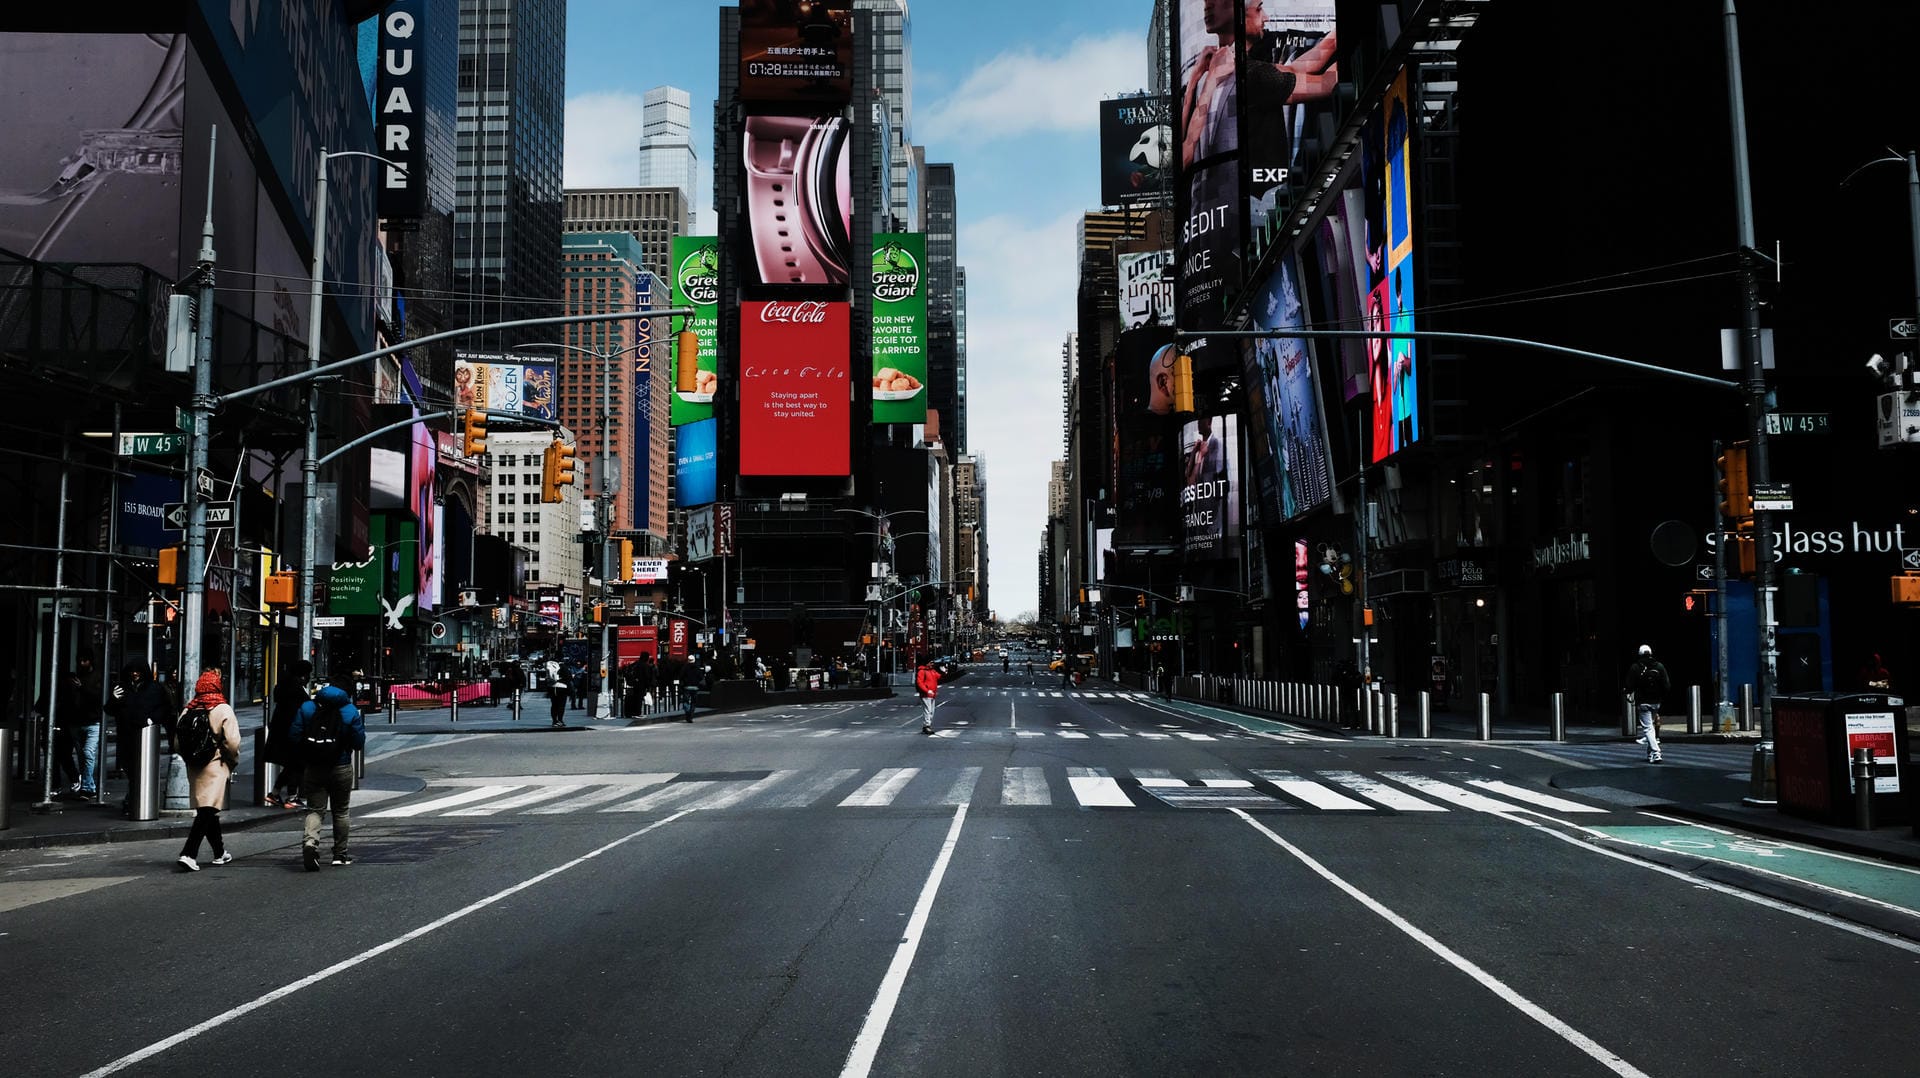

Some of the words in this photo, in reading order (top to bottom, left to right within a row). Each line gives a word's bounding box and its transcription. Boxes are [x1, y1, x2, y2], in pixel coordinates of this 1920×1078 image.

[334, 9, 352, 128] YOU
[749, 63, 782, 75] 07:28
[383, 11, 415, 189] QUARE
[1252, 168, 1289, 183] EXP
[291, 90, 346, 294] WORERS!
[1128, 252, 1171, 281] LITTLE
[873, 272, 916, 285] Green
[690, 287, 718, 299] Gia
[875, 284, 917, 297] Giant
[872, 336, 898, 344] EGGIE
[899, 336, 918, 344] TOT
[881, 346, 920, 354] ARRIVED
[474, 366, 485, 385] KING
[474, 385, 484, 405] LION
[504, 367, 519, 411] ROZEN
[770, 391, 798, 401] Staying
[799, 392, 818, 401] apart
[773, 410, 789, 419] stay
[790, 410, 815, 418] united.
[802, 403, 817, 411] way
[1782, 417, 1794, 432] W
[1799, 416, 1815, 432] 45
[1818, 416, 1827, 426] St
[137, 438, 150, 452] W
[155, 436, 171, 451] 45
[177, 436, 186, 446] St
[124, 501, 137, 514] 1515
[174, 510, 188, 521] ON
[1705, 521, 1844, 563] sglass
[1852, 521, 1906, 553] hut
[1533, 535, 1570, 574] sunglass
[1461, 567, 1483, 575] POLO
[674, 621, 685, 643] tkts
